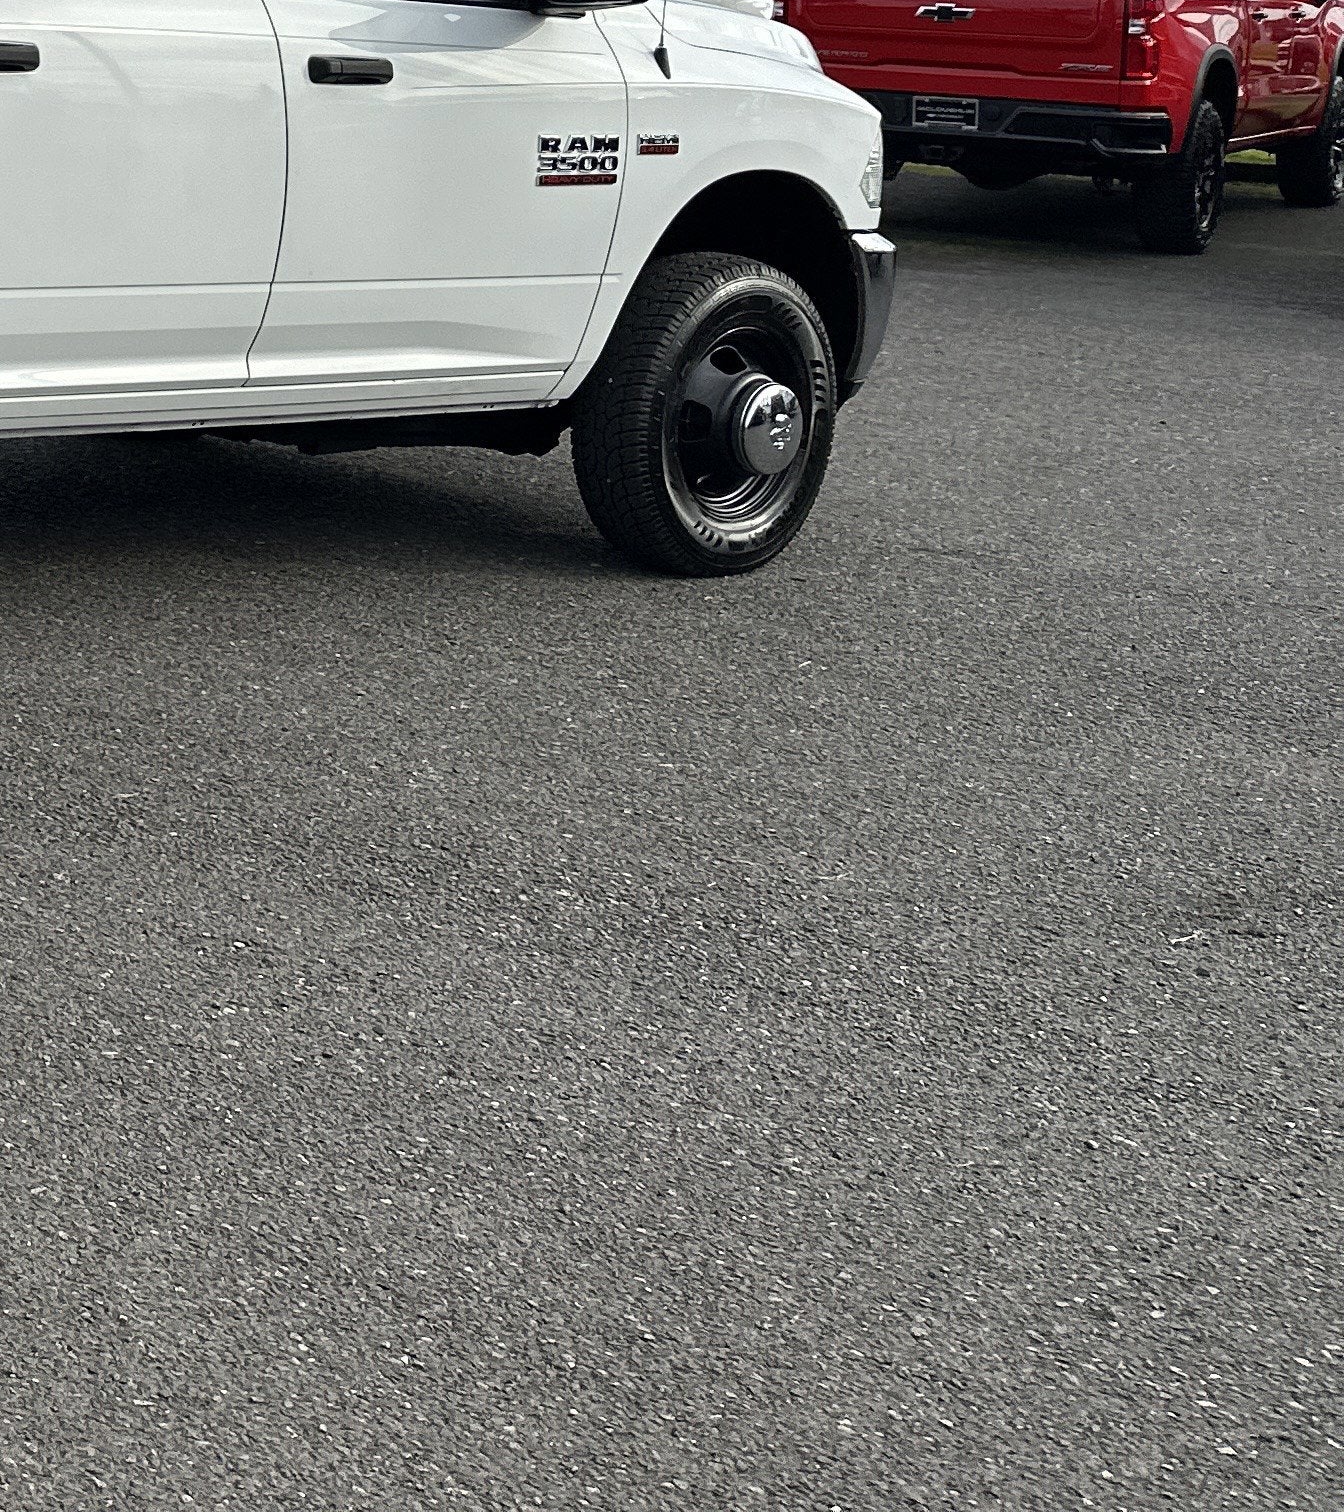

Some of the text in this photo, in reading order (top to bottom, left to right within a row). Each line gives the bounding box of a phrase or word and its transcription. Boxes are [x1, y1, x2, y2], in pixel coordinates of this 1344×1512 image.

[538, 134, 620, 153] RAM
[537, 155, 619, 172] 3500
[543, 175, 615, 184] HEAVY DUTY
